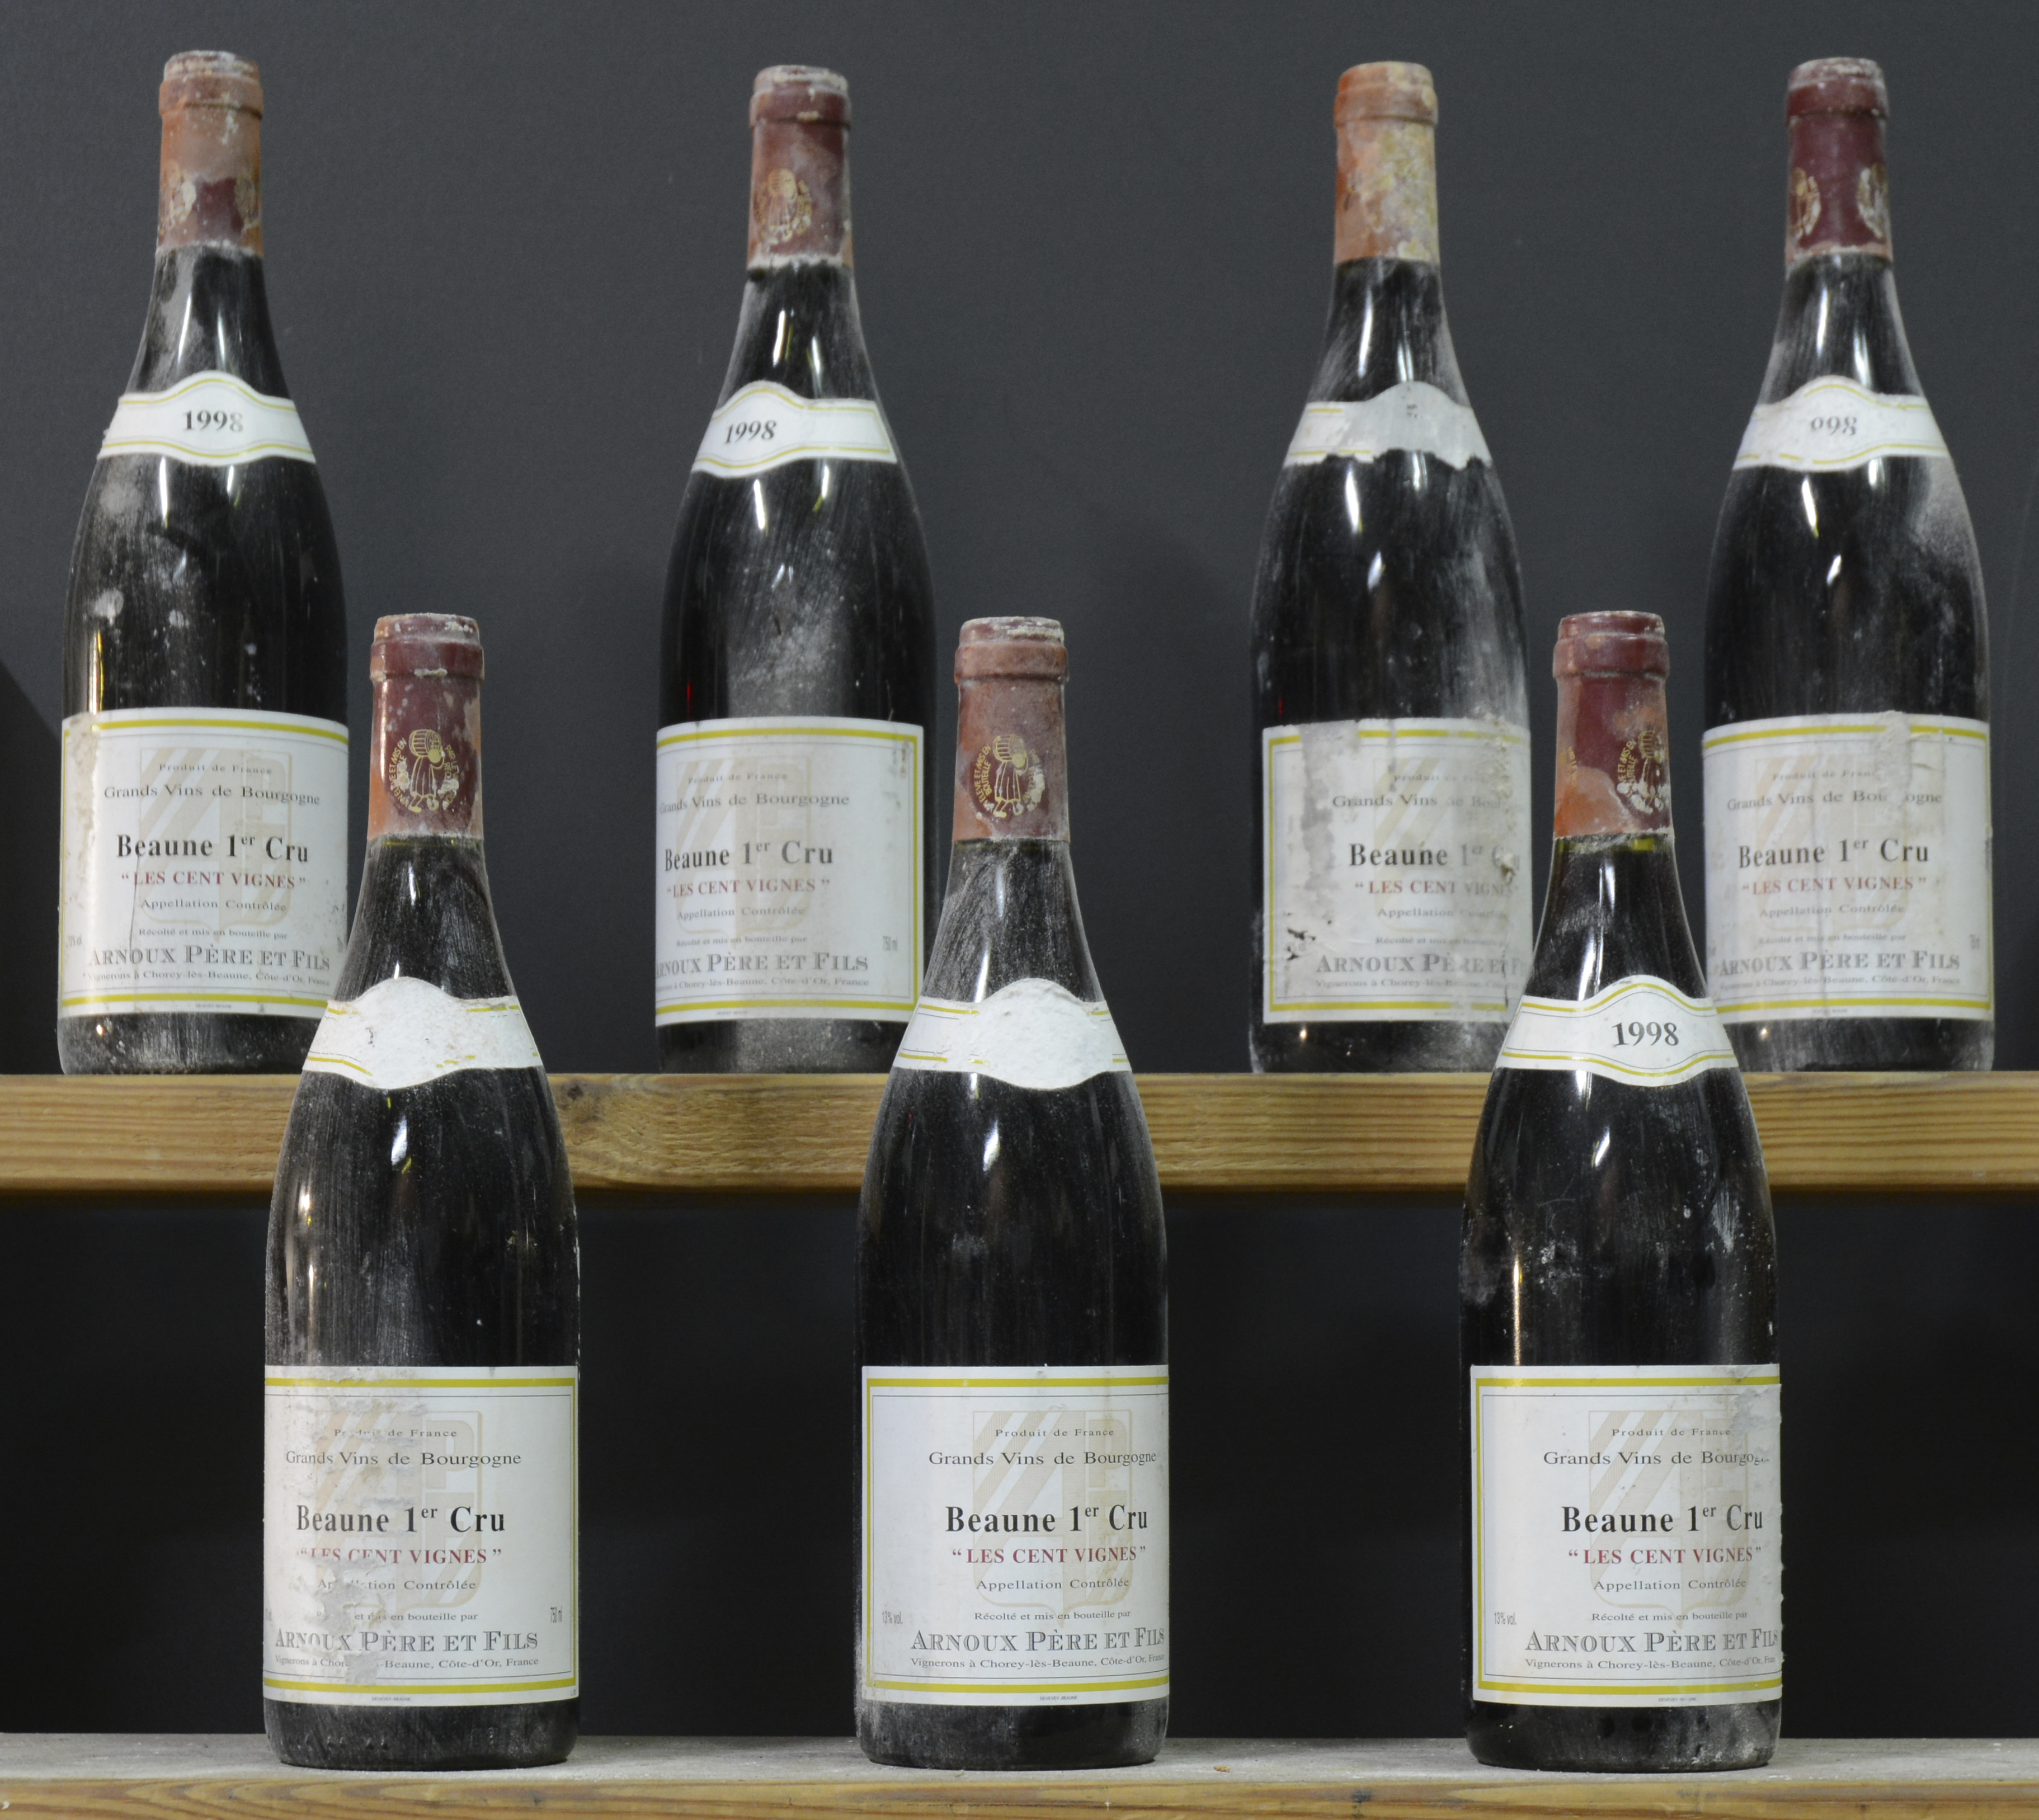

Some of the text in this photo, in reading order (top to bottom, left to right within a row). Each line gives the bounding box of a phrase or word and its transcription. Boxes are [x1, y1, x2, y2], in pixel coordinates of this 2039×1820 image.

[182, 411, 244, 430] 1998
[726, 421, 777, 444] 1998
[974, 770, 980, 778] ET
[977, 753, 986, 768] MIS
[104, 784, 319, 805] Grands Vins de Bourgogne
[1332, 793, 1438, 808] Grands Vins
[1727, 790, 1843, 811] Grands Vins de
[660, 793, 850, 814] Grands Vins de Bourgogne
[118, 834, 308, 862] Beaune 1er Cru
[665, 841, 833, 871] Beaune 1er Cru
[1349, 843, 1447, 866] Beaune
[1739, 839, 1928, 869] Beaune 1er Cru
[173, 871, 224, 885] CENT
[1787, 877, 1836, 892] CENT
[698, 880, 740, 895] CENT
[1410, 880, 1455, 894] CENT
[89, 944, 329, 970] ARNOUX PÈRE ET FILS
[707, 951, 768, 972] PÈRE
[776, 955, 807, 970] ET
[813, 952, 868, 971] FILS
[1316, 955, 1415, 973] ARNOUX
[1718, 949, 1960, 977] ARNOUX PÈRE ET FILS
[1612, 1021, 1679, 1046] 1998
[411, 1429, 457, 1437] France
[995, 1429, 1046, 1437] Produit
[1053, 1428, 1068, 1437] de
[1670, 1428, 1685, 1436] de
[286, 1450, 521, 1468] Grands Vins de Bourgogne
[929, 1451, 1156, 1467] Grands Vins de Bourgogne
[1543, 1451, 1692, 1465] Grands Vins de
[296, 1505, 505, 1533] Beaune 1er Cru
[945, 1504, 1148, 1533] Beaune 1er Cru
[1561, 1504, 1763, 1533] Beaune 1er Cru
[1013, 1549, 1068, 1564] CENT
[1630, 1549, 1686, 1564] CENT
[404, 1580, 476, 1590] Contrôlée
[976, 1577, 1129, 1592] Appellation Contrôlée
[1593, 1578, 1746, 1592] Appellation Contrôlée
[408, 1612, 456, 1621] bouteille
[882, 1611, 903, 1624] 13% vol.
[1073, 1610, 1115, 1619] bouteille
[1494, 1612, 1517, 1625] 13% vol.
[1692, 1611, 1733, 1620] bouteille
[1735, 1612, 1748, 1620] par
[359, 1630, 435, 1652] PÈRE
[444, 1635, 477, 1652] ET
[483, 1630, 538, 1651] FILS
[911, 1627, 1164, 1652] ARNOUX PÈRE ET FILS
[1525, 1628, 1778, 1653] ARNOUX PÈRE ET FILS
[275, 1656, 309, 1666] Vignerons
[312, 1658, 317, 1666] à
[911, 1653, 1165, 1670] Vignerons à Chorey-lès-Beaune, Côte-d'Or, France
[1525, 1658, 1583, 1670] Vignerons
[1598, 1660, 1716, 1671] Chorey-lès-Beaune,
